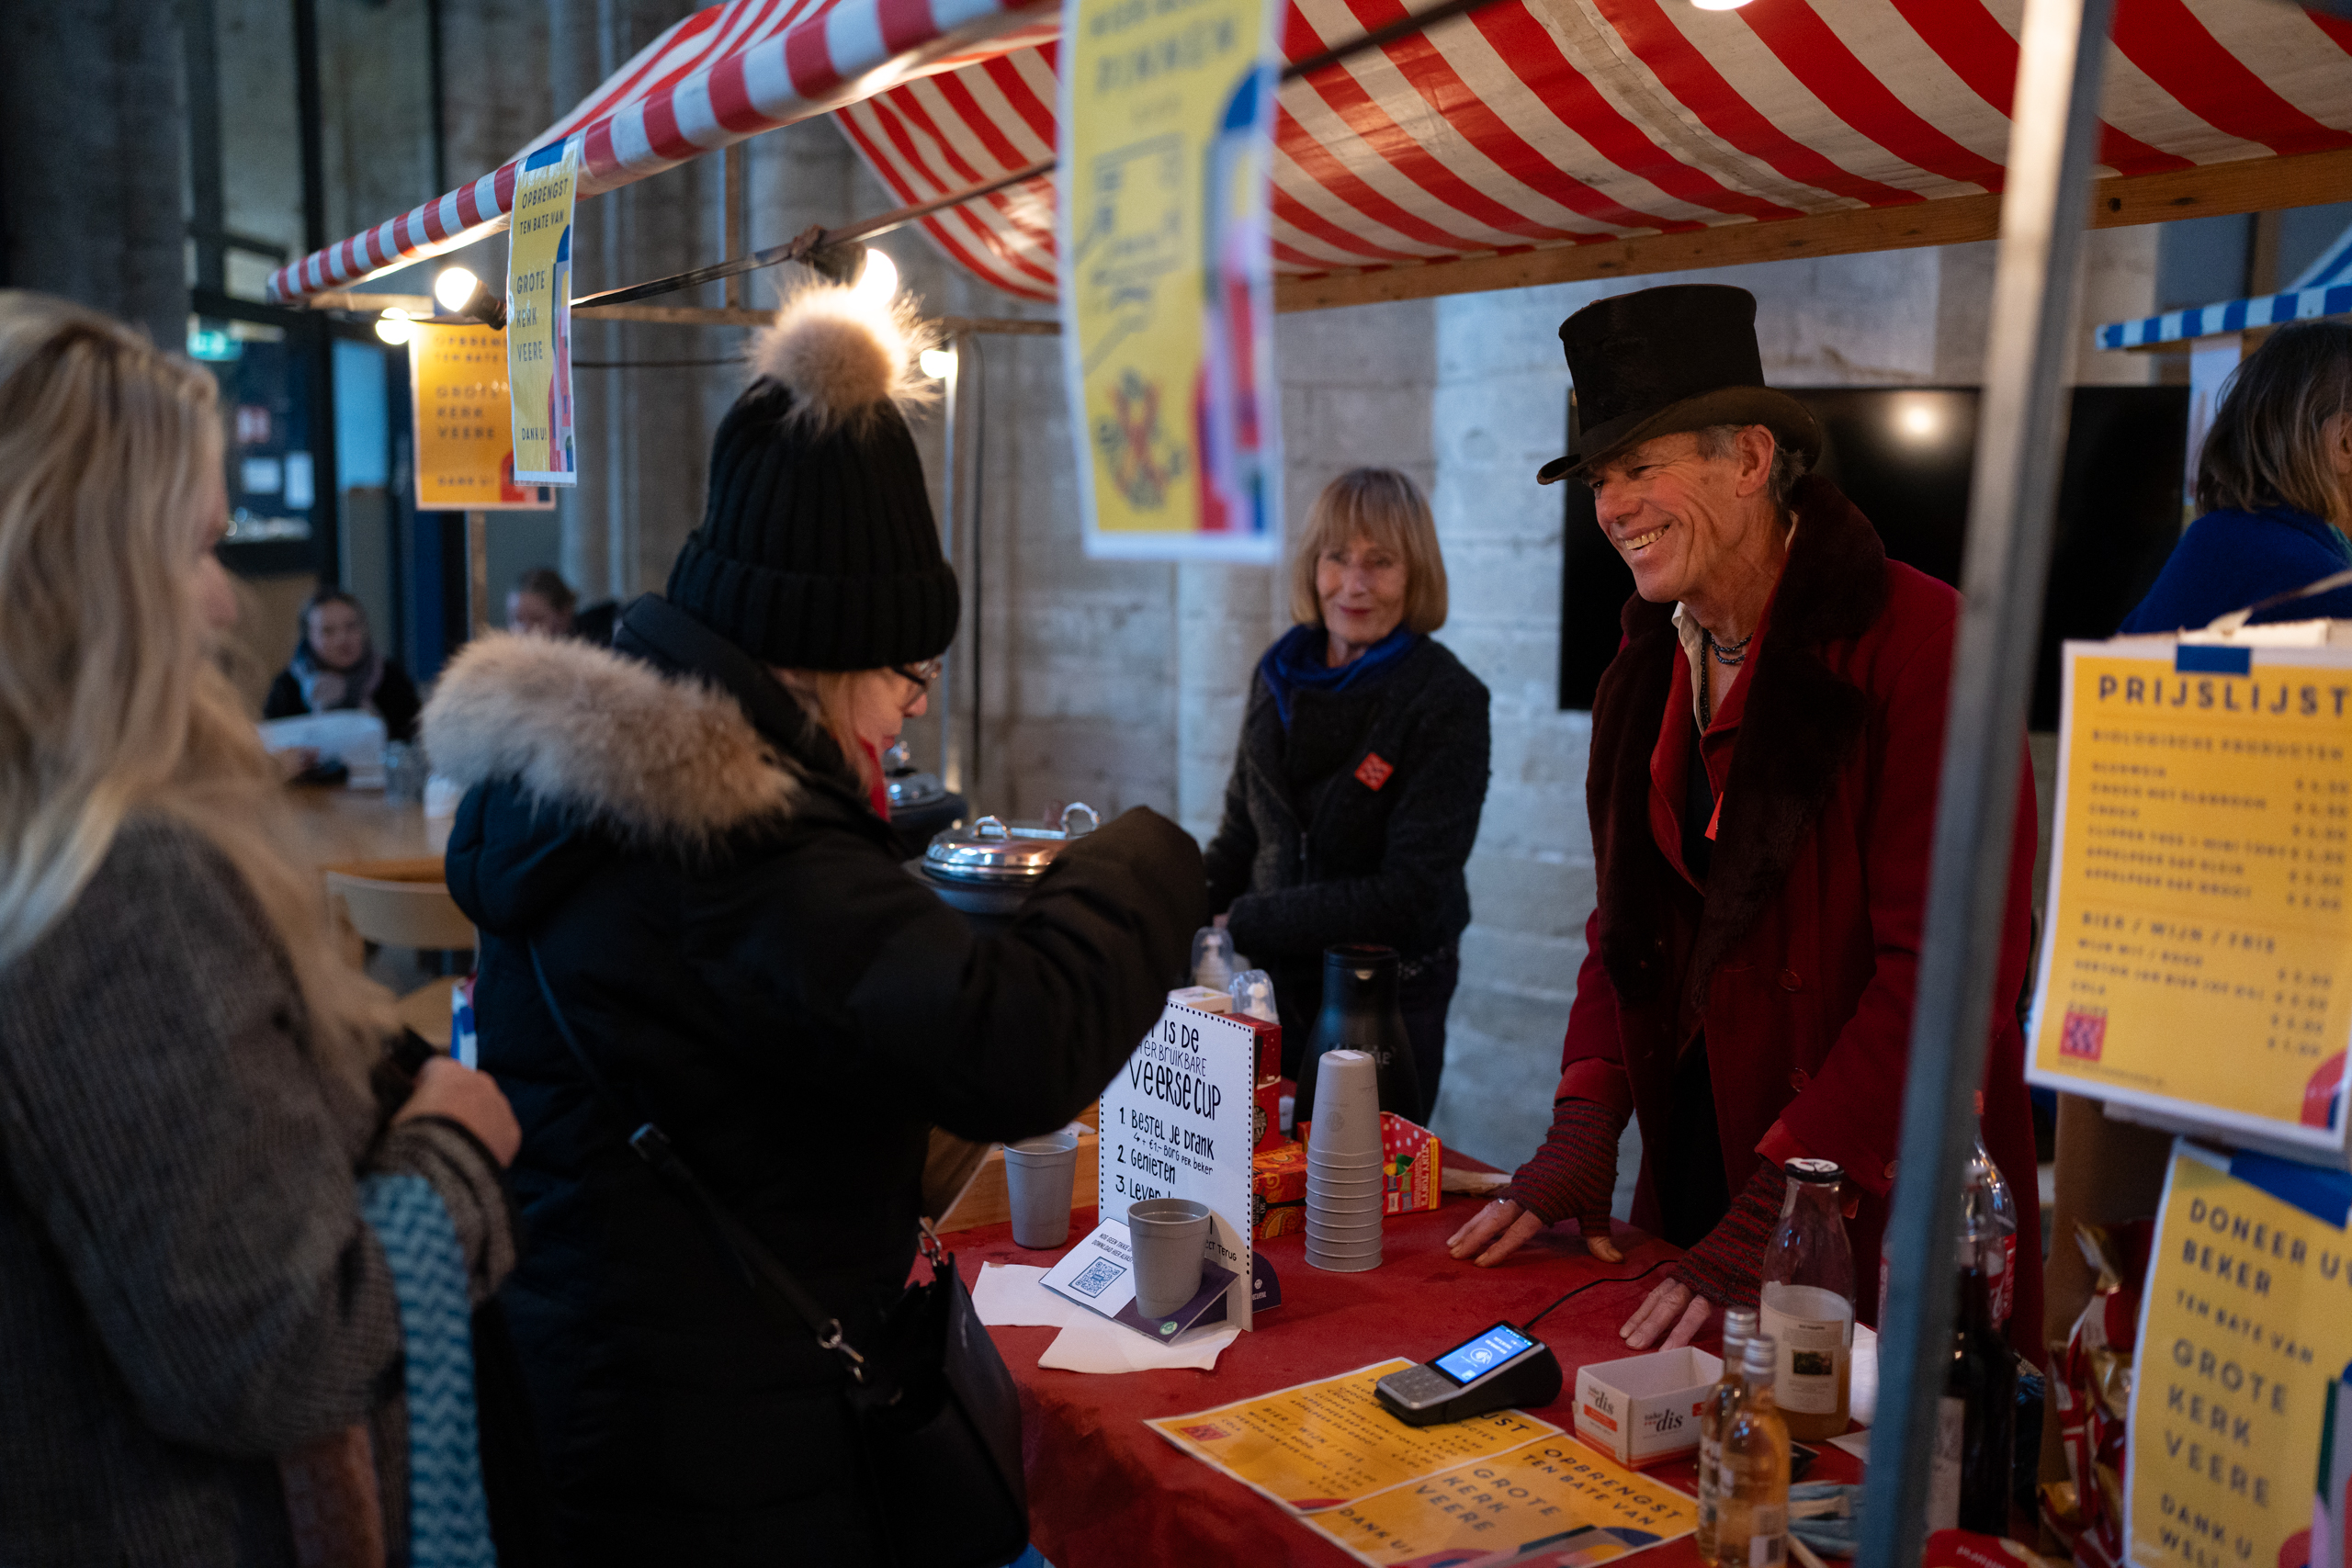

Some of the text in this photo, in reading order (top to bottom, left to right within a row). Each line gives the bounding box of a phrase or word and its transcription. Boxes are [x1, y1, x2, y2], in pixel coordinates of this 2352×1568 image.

[522, 178, 568, 209] OPBRENGST
[519, 209, 564, 235] TEN BATE VAN
[516, 270, 546, 295] GROTE
[516, 306, 537, 328] KERK
[516, 340, 543, 362] VEERE
[435, 384, 499, 400] GROTE
[436, 404, 483, 419] KERK
[436, 425, 495, 441] VEERE
[521, 426, 548, 441] DANK U!
[436, 474, 475, 488] DANK
[2098, 673, 2350, 719] PRIJSLIJST
[2082, 911, 2125, 930] BIER
[2151, 922, 2203, 942] WIJN
[2228, 931, 2275, 955] FRIS
[1119, 1107, 1125, 1125] 1.
[1116, 1145, 1126, 1164] 2.
[1182, 1156, 1192, 1168] PER
[1193, 1156, 1214, 1176] beker
[1421, 1146, 1430, 1171] TINY
[1115, 1174, 1126, 1195] 3.
[1099, 1233, 1109, 1241] NOG
[1106, 1236, 1118, 1246] GEEN
[1116, 1241, 1130, 1251] TIKKIE
[2188, 1196, 2308, 1268] DONEER
[1091, 1239, 1114, 1253] DOWNLOAD
[1111, 1248, 1122, 1258] HIER
[2181, 1237, 2272, 1298] BEKER
[2176, 1288, 2314, 1365] TEN BATE VAN
[2172, 1337, 2286, 1416] GROTE
[1595, 1392, 1614, 1416] dis
[2167, 1382, 2250, 1449] KERK
[1656, 1408, 1683, 1432] dis
[1262, 1407, 1288, 1422] BIER
[1297, 1426, 1327, 1444] WIJN
[1338, 1448, 1363, 1462] FRIS
[2165, 1428, 2269, 1510] VEERE
[1442, 1476, 1510, 1513] KERK
[1473, 1468, 1561, 1516] GROTE
[1523, 1454, 1656, 1526] TEN BATE VAN
[1544, 1449, 1682, 1519] OPBRENGST
[1415, 1484, 1495, 1532] VEERE
[1339, 1507, 1390, 1539] DANK
[2160, 1492, 2252, 1561] DANK U
